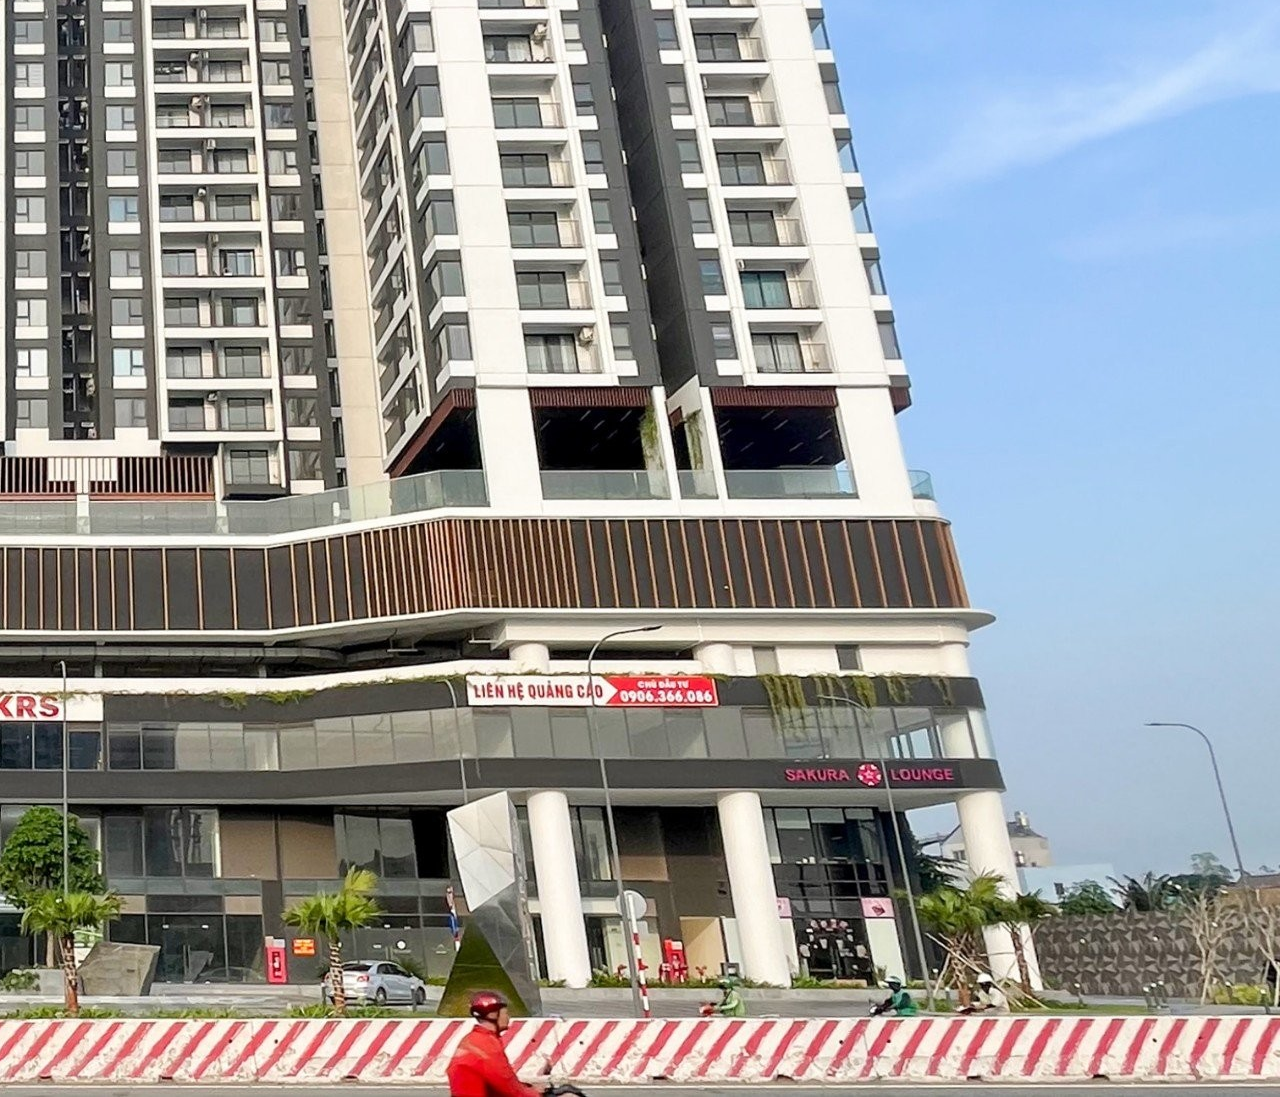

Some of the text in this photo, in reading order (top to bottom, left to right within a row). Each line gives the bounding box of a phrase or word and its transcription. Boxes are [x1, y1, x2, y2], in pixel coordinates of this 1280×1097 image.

[474, 679, 603, 702] LIÊN HỆ QUẢNG CÁO
[637, 679, 657, 689] CHỦ
[619, 689, 712, 703] 0906.366.086
[784, 767, 955, 783] SAKURA LOUNGE
